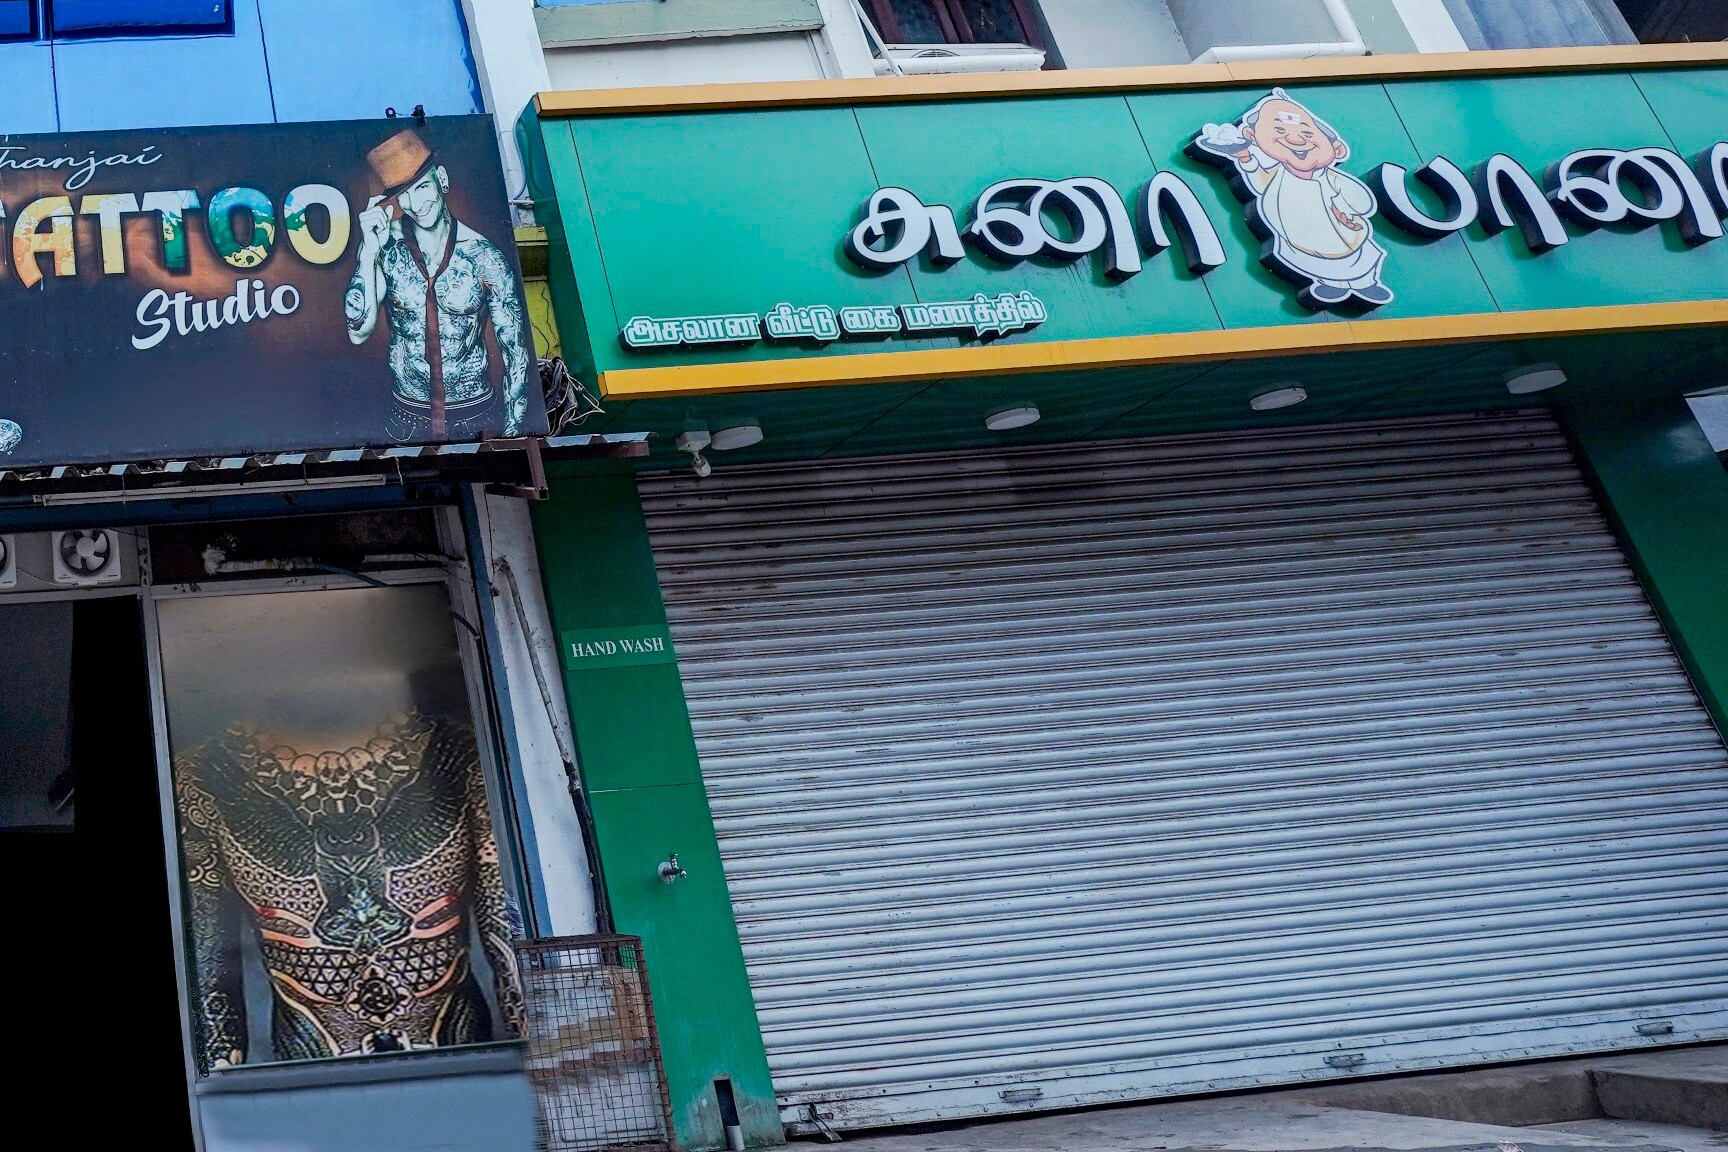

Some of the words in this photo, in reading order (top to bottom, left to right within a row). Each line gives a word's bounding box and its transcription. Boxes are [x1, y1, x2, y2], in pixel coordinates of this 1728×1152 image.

[1379, 141, 1728, 247] பான
[131, 278, 300, 350] Studio
[571, 641, 617, 657] HAND
[619, 637, 664, 654] WASH
